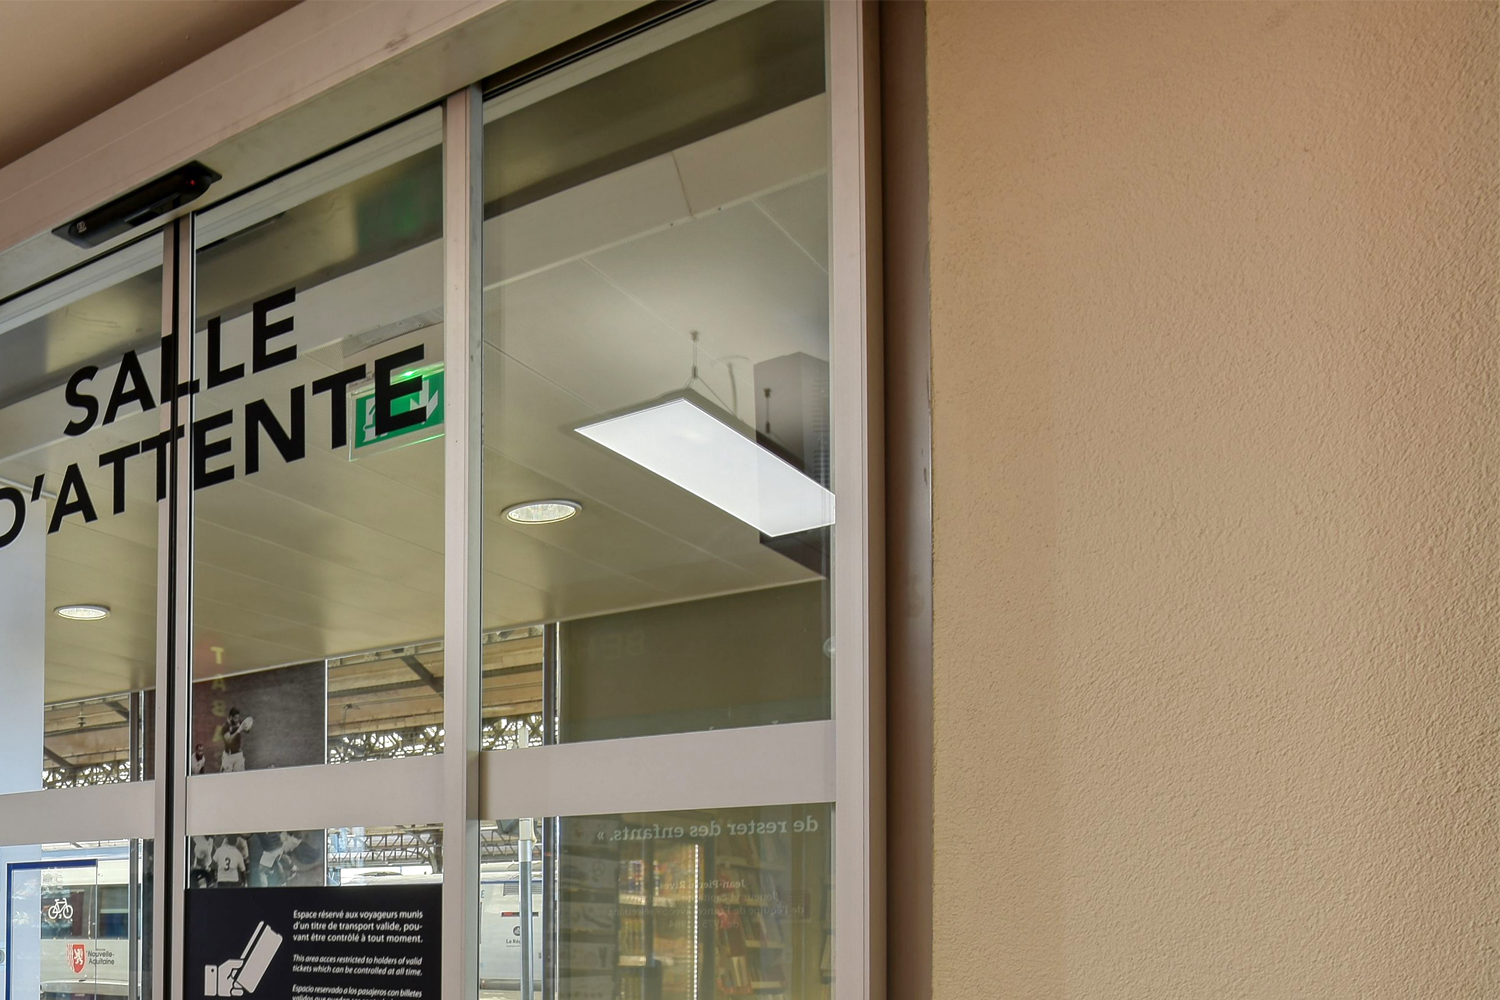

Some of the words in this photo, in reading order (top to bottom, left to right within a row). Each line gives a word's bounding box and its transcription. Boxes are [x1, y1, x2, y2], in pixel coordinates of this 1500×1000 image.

[63, 286, 298, 436] SALLE
[224, 857, 231, 871] 3
[293, 909, 317, 920] Espace
[318, 909, 344, 919] réservé
[345, 911, 358, 919] aux
[359, 911, 398, 921] voyageurs
[399, 909, 423, 919] munis
[293, 921, 309, 930] d'un
[311, 921, 326, 930] titre
[327, 921, 338, 930] de
[339, 922, 374, 932] transport
[376, 921, 402, 932] valide,
[403, 922, 423, 933] pou-
[293, 933, 309, 942] vant
[311, 932, 326, 942] être
[327, 932, 359, 943] contrôlé
[360, 932, 366, 942] à
[367, 934, 384, 943] tout
[386, 934, 423, 944] moment.
[293, 954, 305, 963] This
[305, 955, 319, 963] area
[319, 955, 336, 964] acces
[336, 955, 366, 964] restricted
[366, 956, 373, 965] to
[373, 955, 397, 965] holders
[397, 956, 406, 965] of
[406, 956, 422, 966] valid
[292, 964, 312, 973] tickets
[312, 964, 331, 974] which
[332, 966, 344, 974] can
[344, 965, 353, 974] be
[353, 965, 387, 976] controlled
[387, 966, 395, 975] at
[395, 966, 404, 976] all
[405, 967, 423, 977] time.
[292, 984, 314, 994] Espacio
[314, 985, 343, 995] reservado
[348, 986, 357, 995] los
[357, 987, 386, 998] pasajeros
[387, 989, 399, 997] con
[400, 988, 423, 998] billetes
